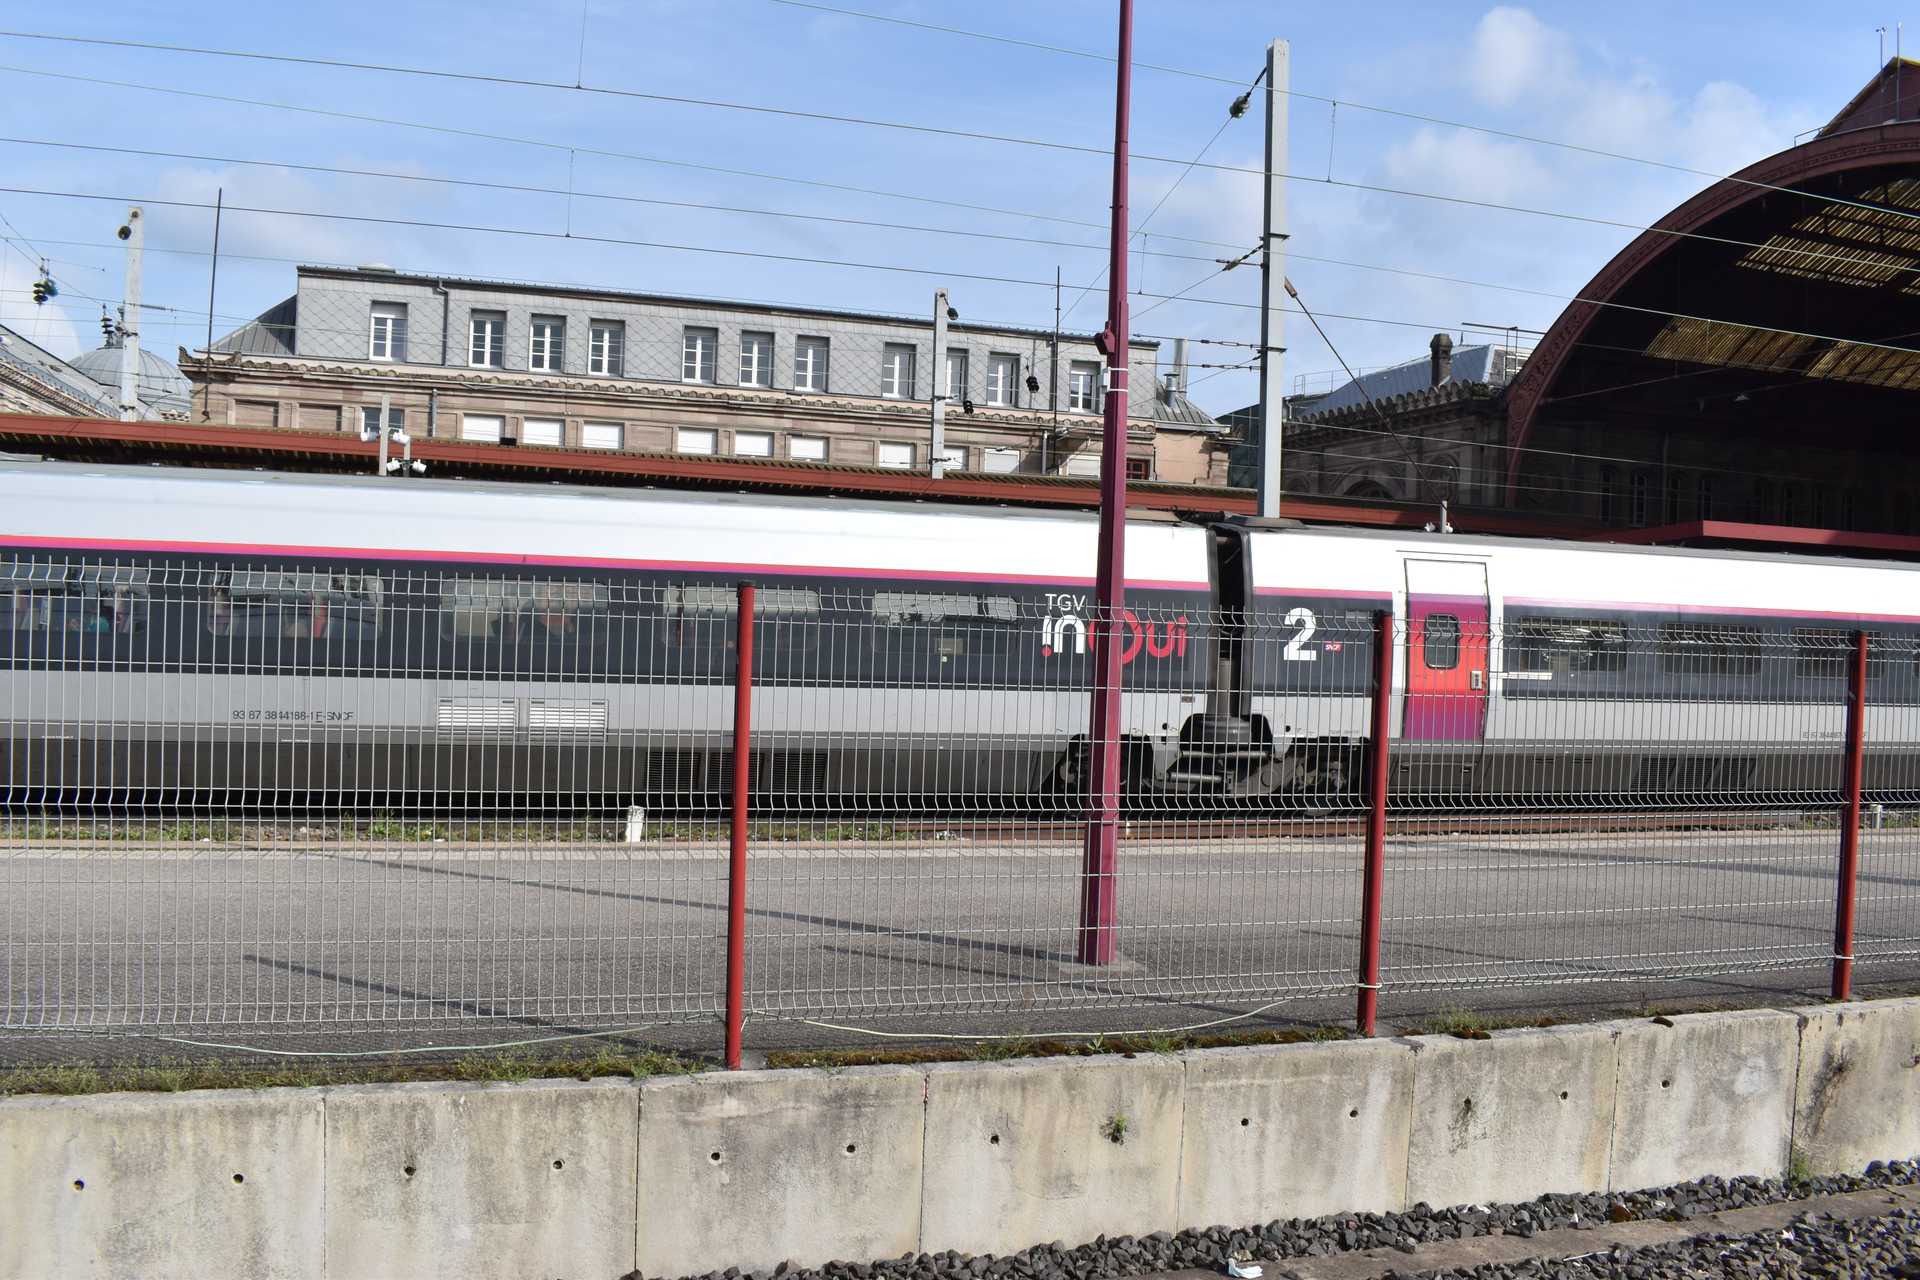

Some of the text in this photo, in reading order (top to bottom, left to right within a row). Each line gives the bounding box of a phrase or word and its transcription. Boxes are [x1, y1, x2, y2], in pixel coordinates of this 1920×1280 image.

[1045, 593, 1086, 611] TGV
[1283, 607, 1317, 661] 2
[233, 710, 246, 720] 93
[248, 710, 261, 720] 87
